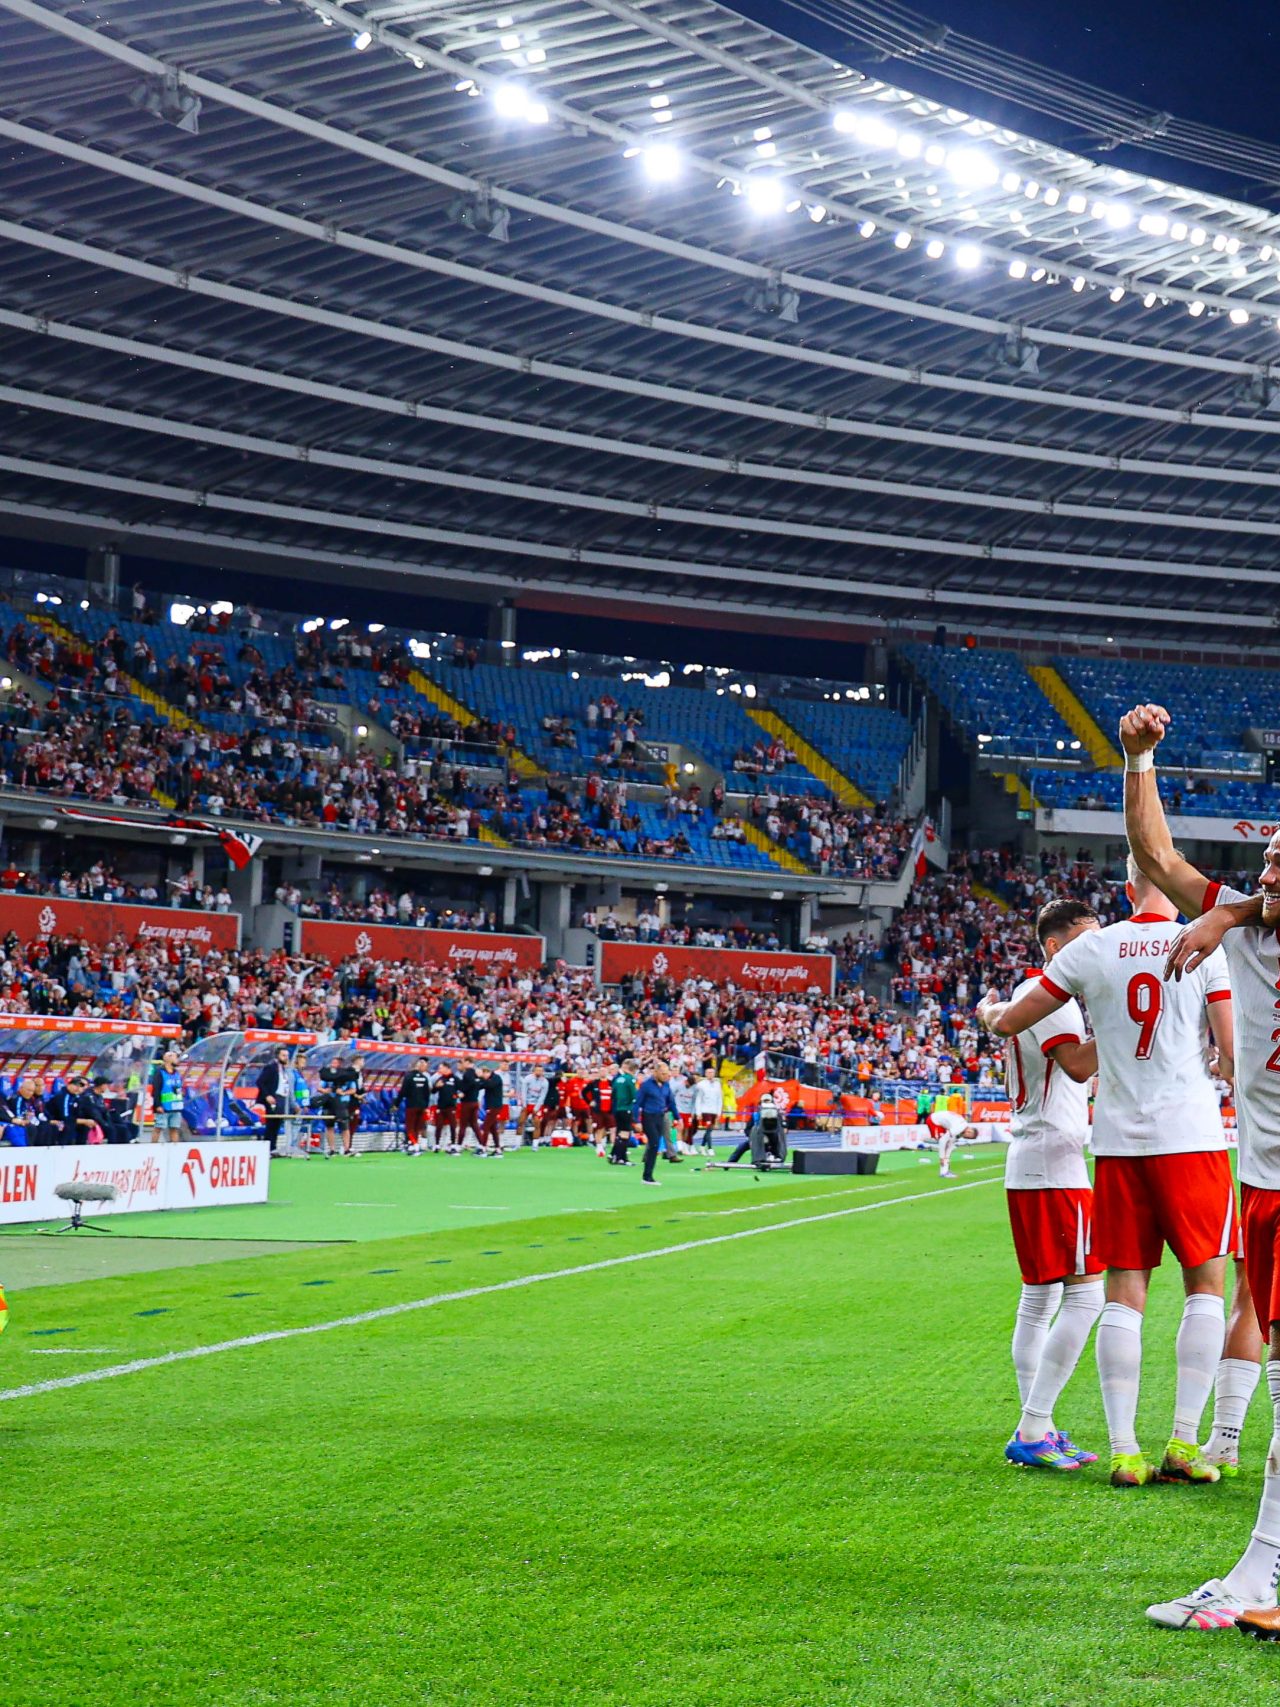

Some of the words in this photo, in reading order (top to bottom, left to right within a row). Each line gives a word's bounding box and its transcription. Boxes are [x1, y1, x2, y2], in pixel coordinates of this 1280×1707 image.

[1119, 940, 1170, 958] BUKSA
[1127, 971, 1164, 1060] 9
[0, 1164, 38, 1203] LEN
[209, 1155, 257, 1189] ORLEN
